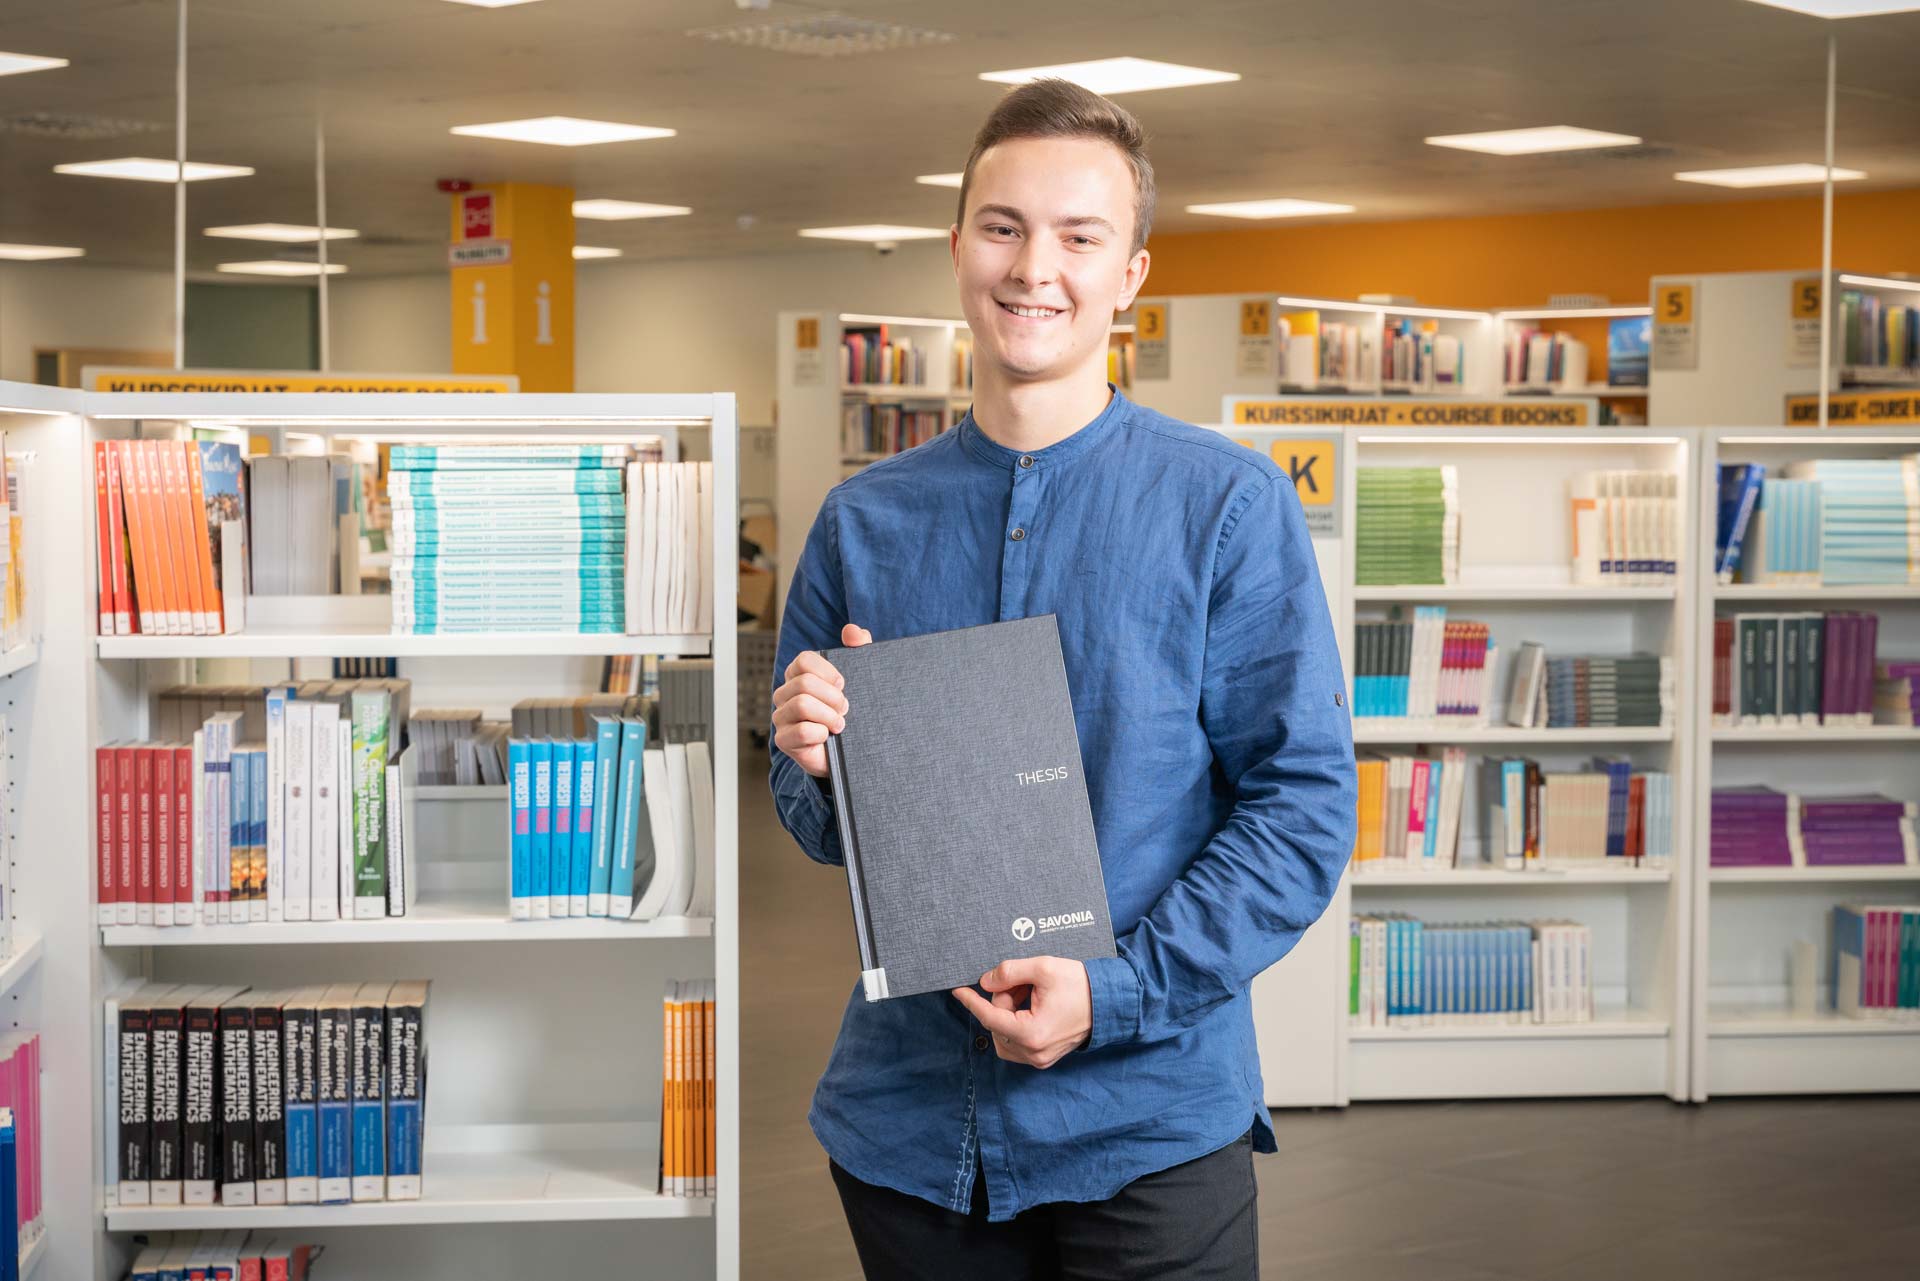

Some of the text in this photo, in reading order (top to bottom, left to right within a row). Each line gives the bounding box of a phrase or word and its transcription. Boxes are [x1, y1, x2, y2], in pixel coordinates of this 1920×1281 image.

[1145, 311, 1158, 333] 3
[1666, 291, 1684, 317] 5
[1245, 407, 1577, 424] KURSSIKIRJAT COURSE BOOKS
[1290, 455, 1319, 493] K
[1015, 766, 1068, 785] THESIS
[1038, 910, 1094, 928] SAVONIA
[121, 1032, 133, 1124] MATHEMATICS
[134, 1032, 146, 1124] ENGINEERING
[153, 1030, 165, 1123] MATHEMATICS
[165, 1030, 178, 1121] ENGINEERING
[186, 1031, 199, 1123] MATHEMATICS
[199, 1031, 212, 1123] ENGINEERING
[223, 1030, 237, 1123] MATHEMATICS
[236, 1029, 250, 1121] ENGINEERING
[254, 1030, 268, 1122] MATHEMATICS
[267, 1030, 281, 1121] ENGINEERING
[286, 1020, 299, 1101] Mathematics
[300, 1025, 314, 1100] Engineering
[319, 1018, 332, 1099] Mathematics
[333, 1024, 348, 1099] Engineering
[354, 1018, 367, 1098] Mathematics
[367, 1024, 382, 1098] Engineering
[390, 1017, 403, 1097] Mathematics
[403, 1022, 418, 1097] Engineering
